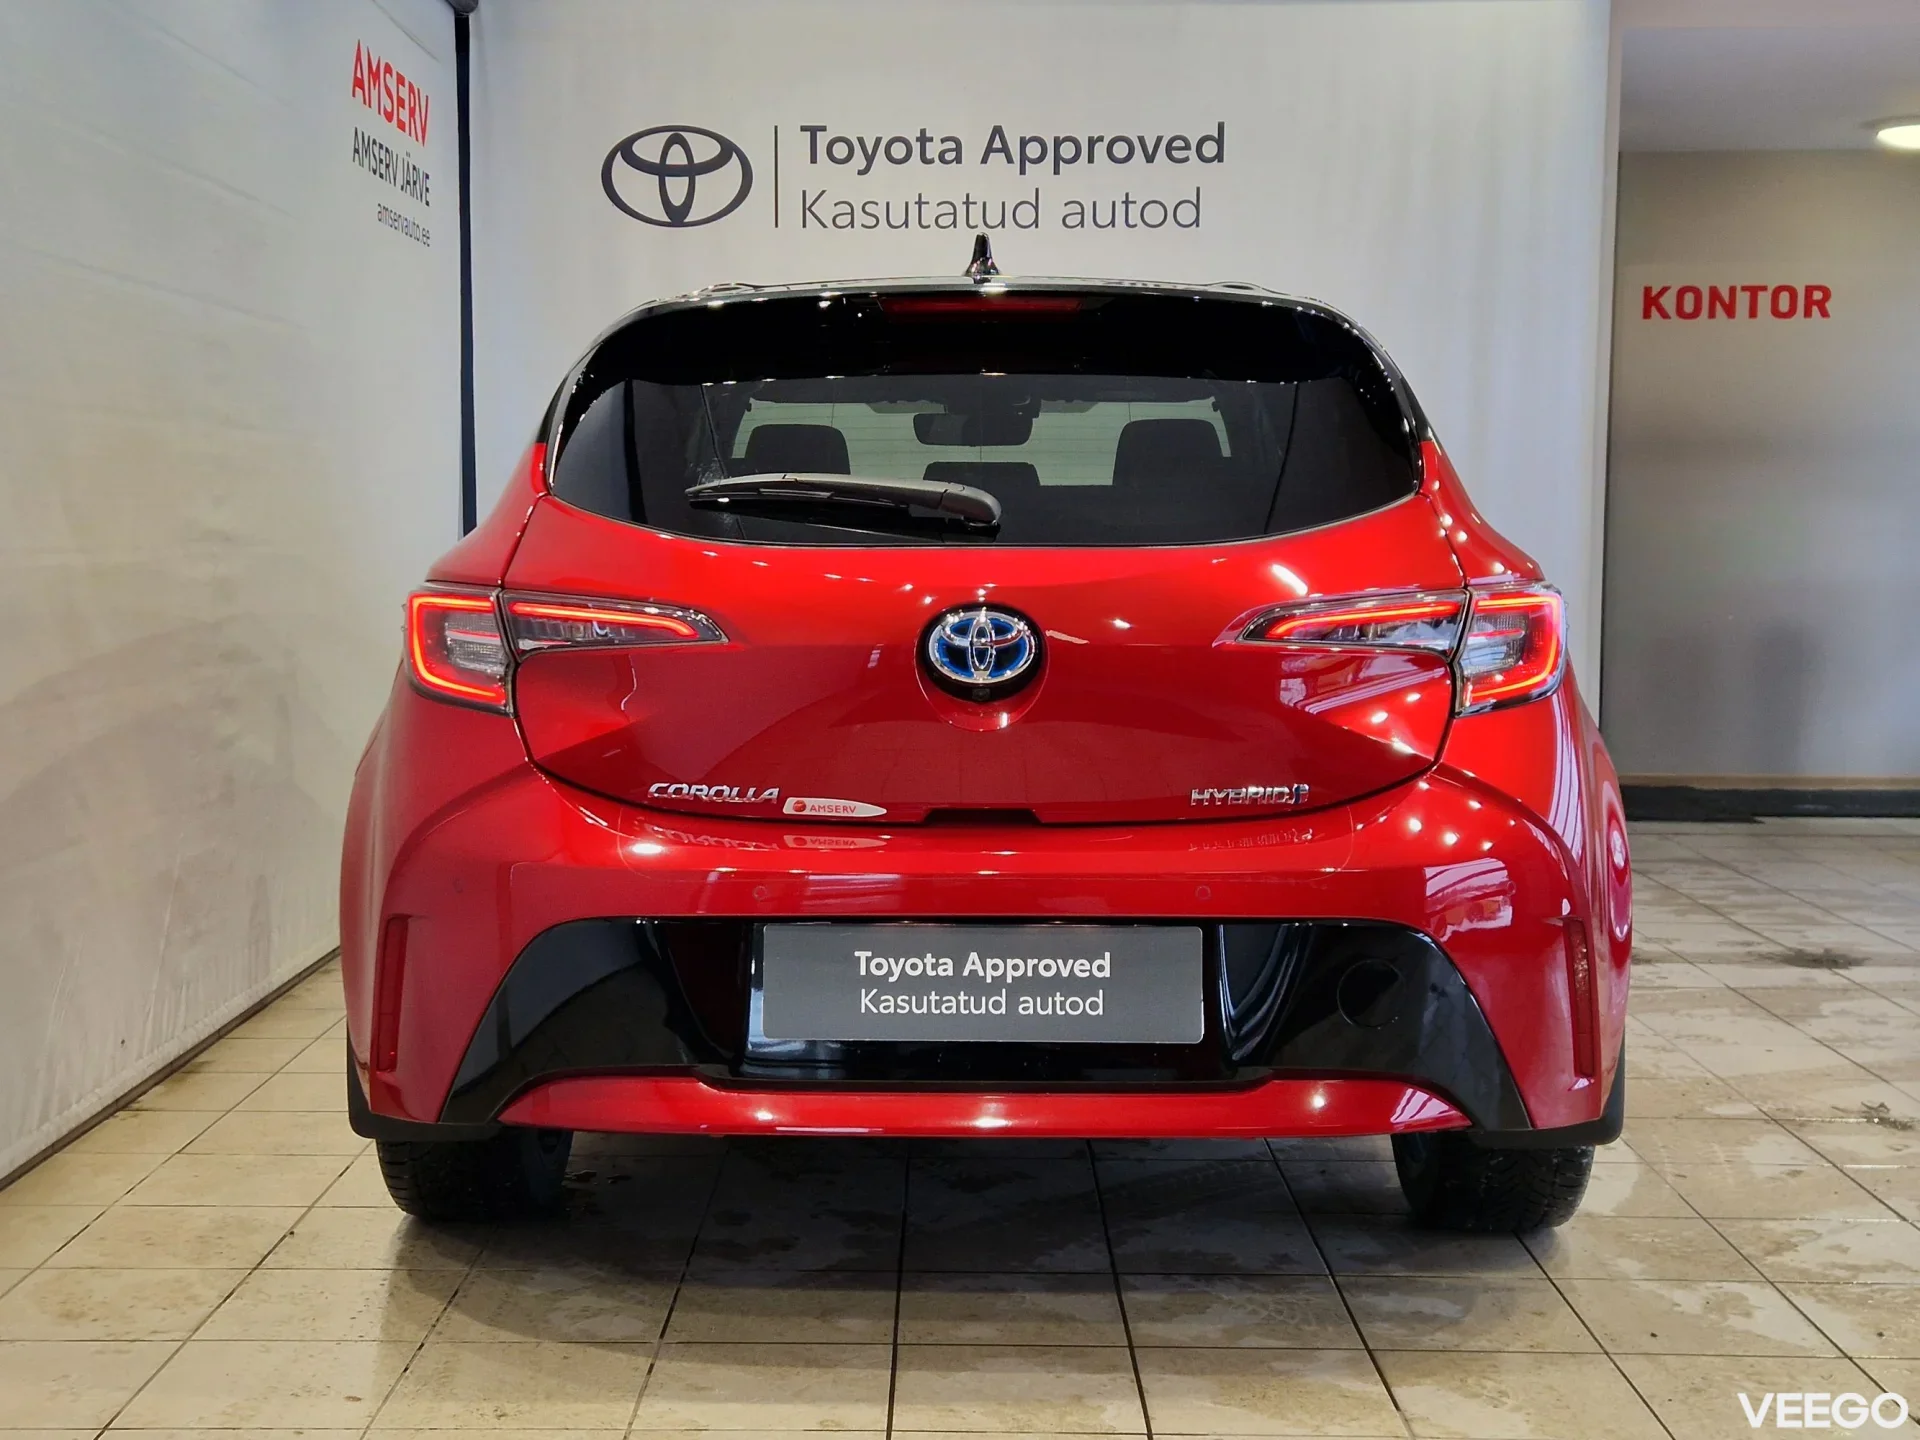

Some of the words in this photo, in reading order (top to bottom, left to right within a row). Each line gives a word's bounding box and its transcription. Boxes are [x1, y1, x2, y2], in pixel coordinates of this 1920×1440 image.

[351, 39, 429, 147] AMSERV
[352, 126, 399, 187] AMSERV
[400, 151, 430, 207] JÄRVE
[799, 124, 964, 176] Toyota
[980, 121, 1226, 176] Approved
[376, 202, 430, 247] amservauto.ee
[800, 187, 1040, 230] Kasutatud
[1061, 186, 1201, 230] autod
[1642, 284, 1832, 320] KONTOR
[647, 782, 780, 804] COROLLA
[809, 804, 857, 814] AMSERV
[1190, 785, 1290, 806] HYBRID
[854, 951, 954, 982] Toyota
[963, 951, 1111, 983] Approved
[860, 988, 1006, 1015] Kasutatud
[1018, 988, 1104, 1016] autod
